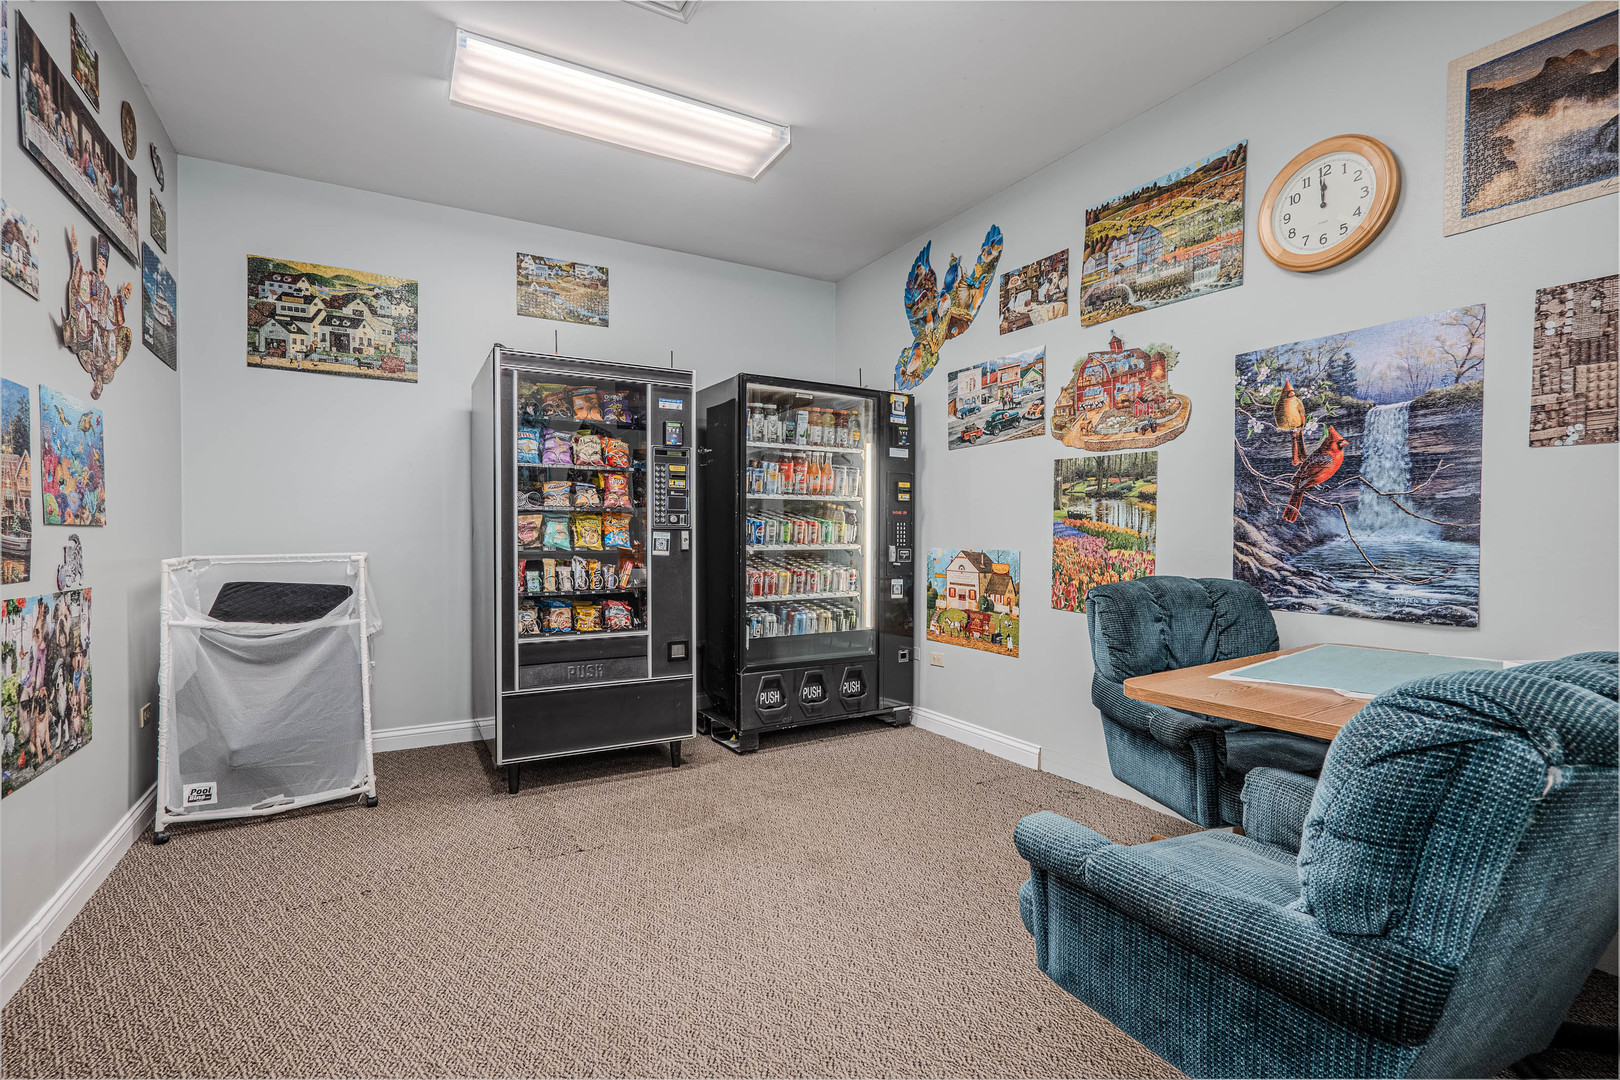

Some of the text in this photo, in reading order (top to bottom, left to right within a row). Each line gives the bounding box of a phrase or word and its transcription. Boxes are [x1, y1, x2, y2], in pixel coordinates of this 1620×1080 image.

[1318, 164, 1332, 178] 12
[1342, 163, 1348, 174] 1
[1353, 170, 1363, 182] 2
[1302, 177, 1311, 189] 11
[1360, 186, 1370, 199] 3
[1289, 192, 1301, 206] 10
[1352, 206, 1361, 217] 4
[1283, 213, 1291, 224] 9
[1288, 227, 1297, 239] 8
[1339, 223, 1349, 235] 5
[1302, 235, 1310, 247] 7
[1319, 233, 1328, 245] 6
[567, 663, 604, 680] PUSH
[802, 685, 822, 699] PUSH
[842, 680, 861, 694] PUSH
[759, 690, 780, 705] PUSH
[190, 787, 211, 796] Pool
